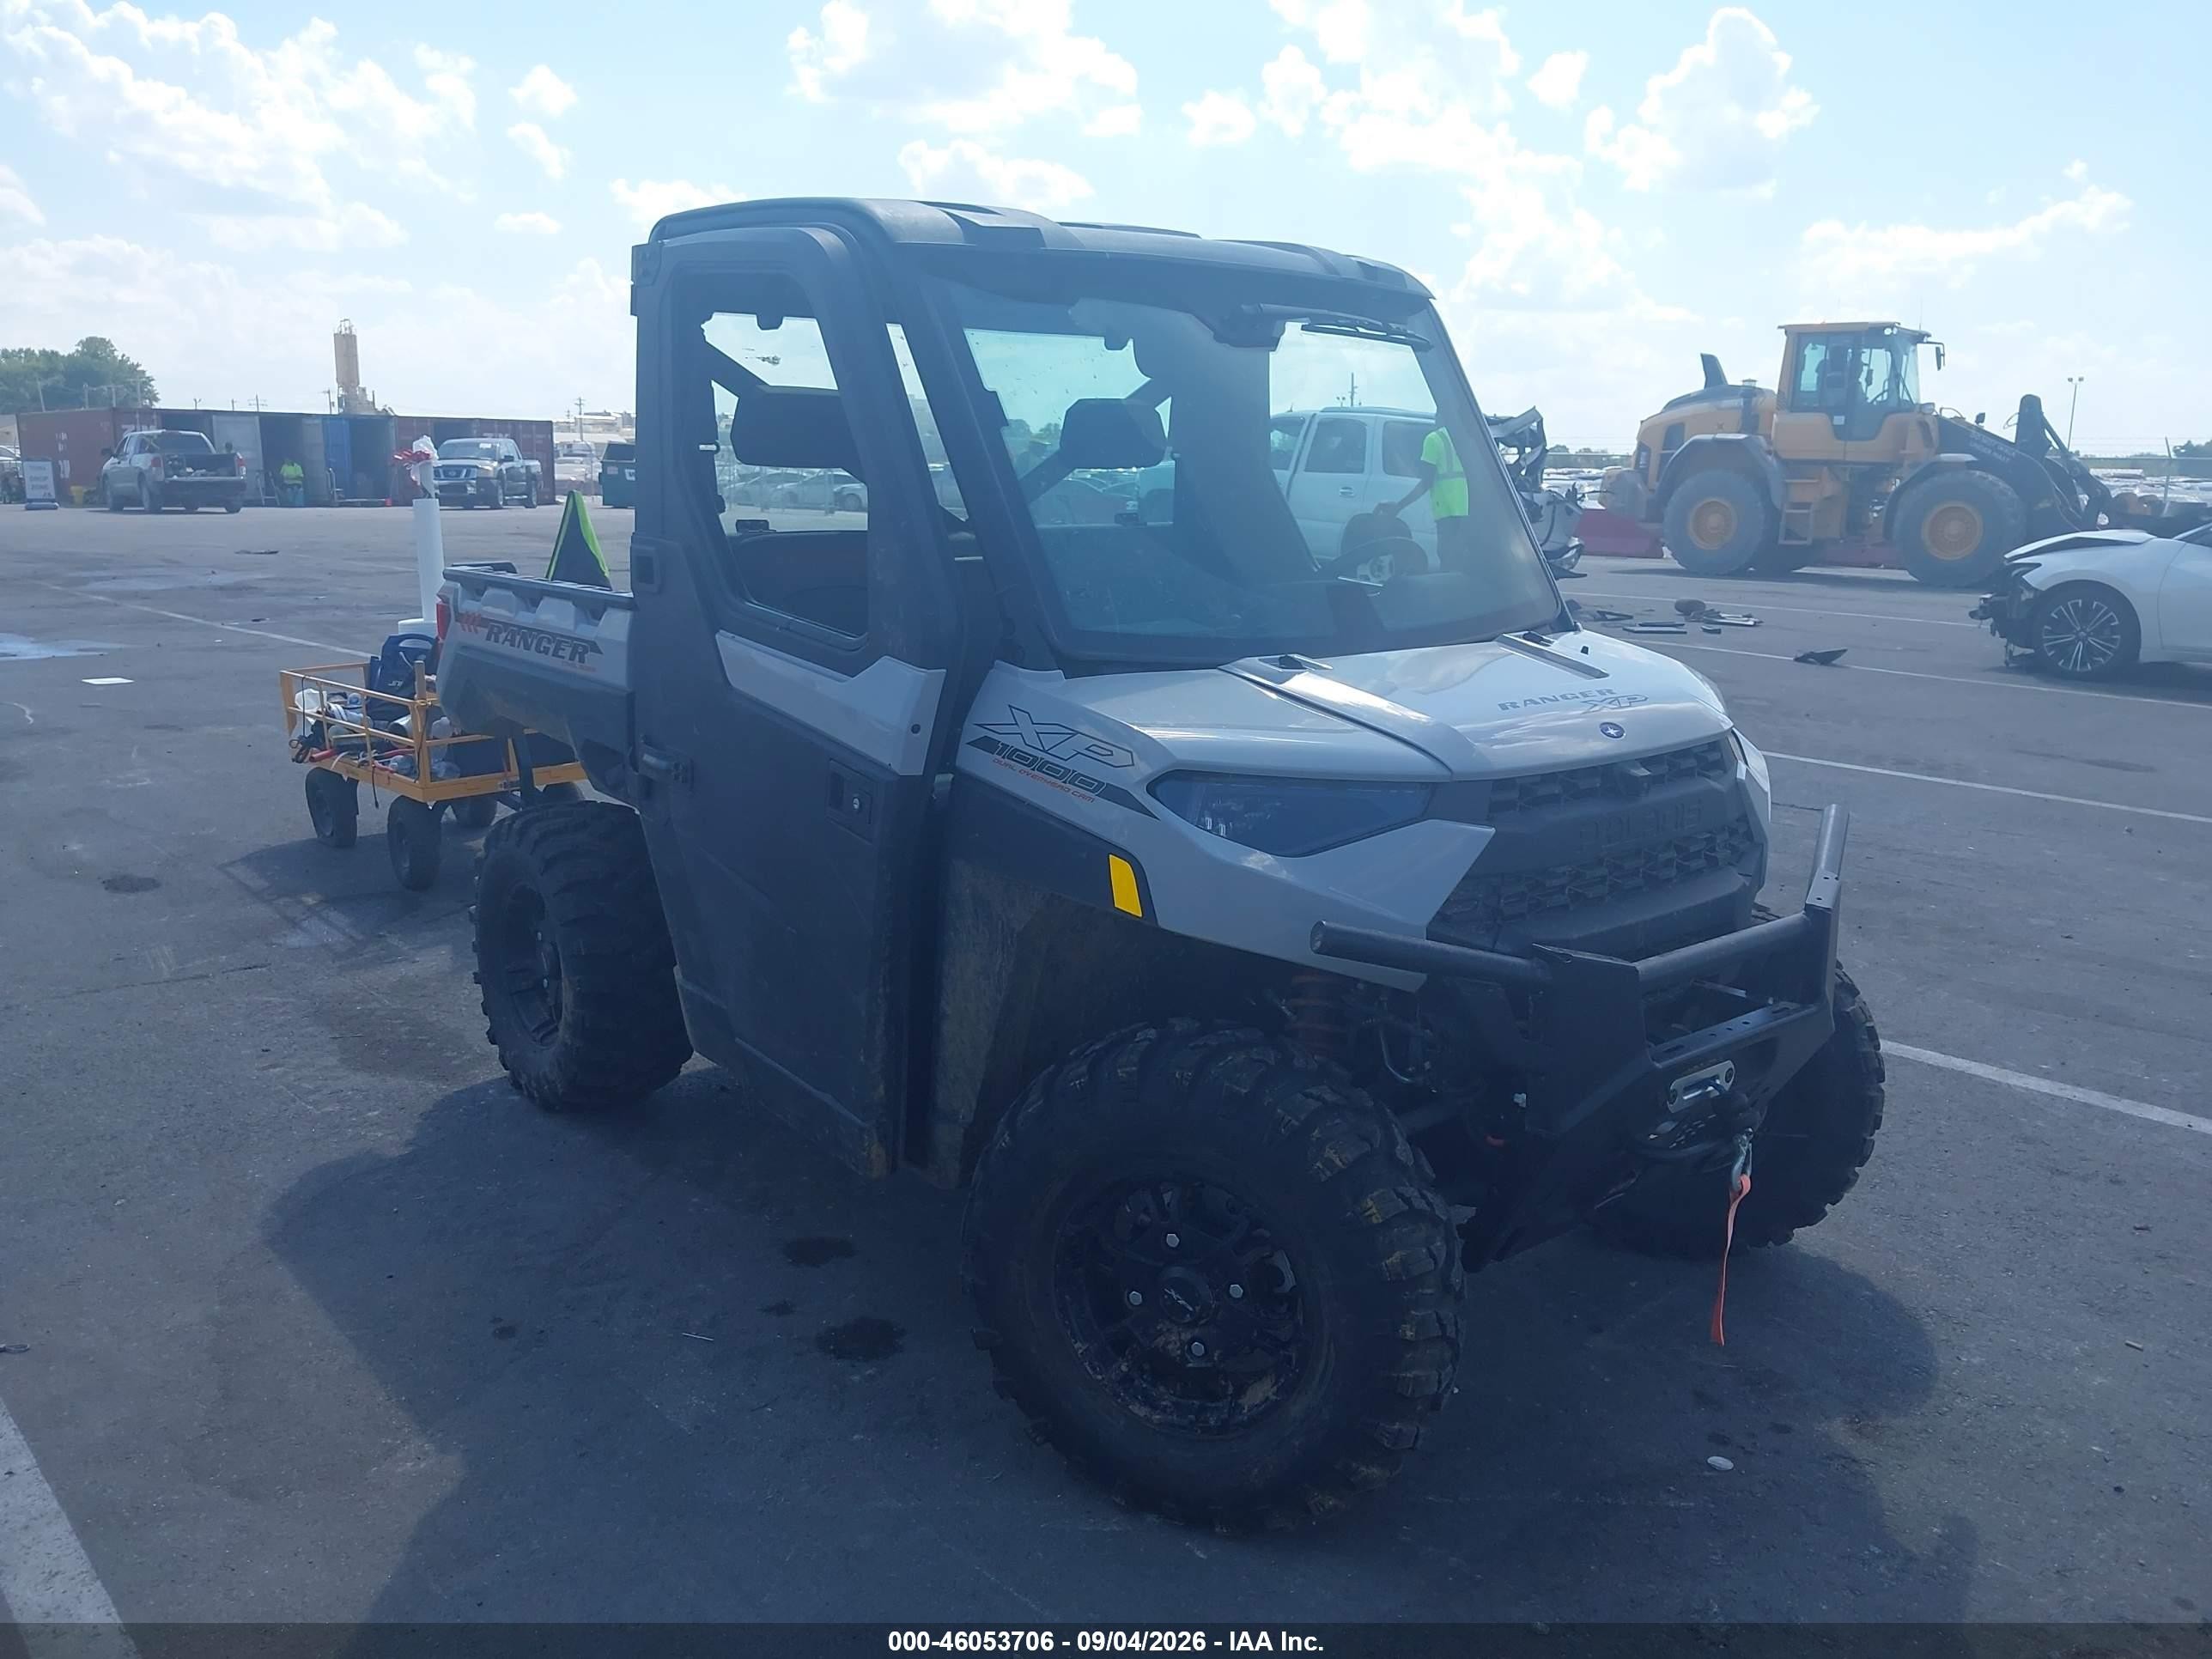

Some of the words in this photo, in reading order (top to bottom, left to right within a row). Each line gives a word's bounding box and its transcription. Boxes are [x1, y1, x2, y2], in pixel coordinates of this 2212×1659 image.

[485, 623, 591, 664] RANGER
[1498, 689, 1616, 711] RANGER
[1579, 694, 1649, 714] XP
[974, 704, 1134, 768] XP
[992, 757, 1018, 772] DUAL
[1018, 768, 1072, 793] OVERHEAD
[1071, 789, 1096, 805] CAM
[994, 742, 1107, 795] 1000
